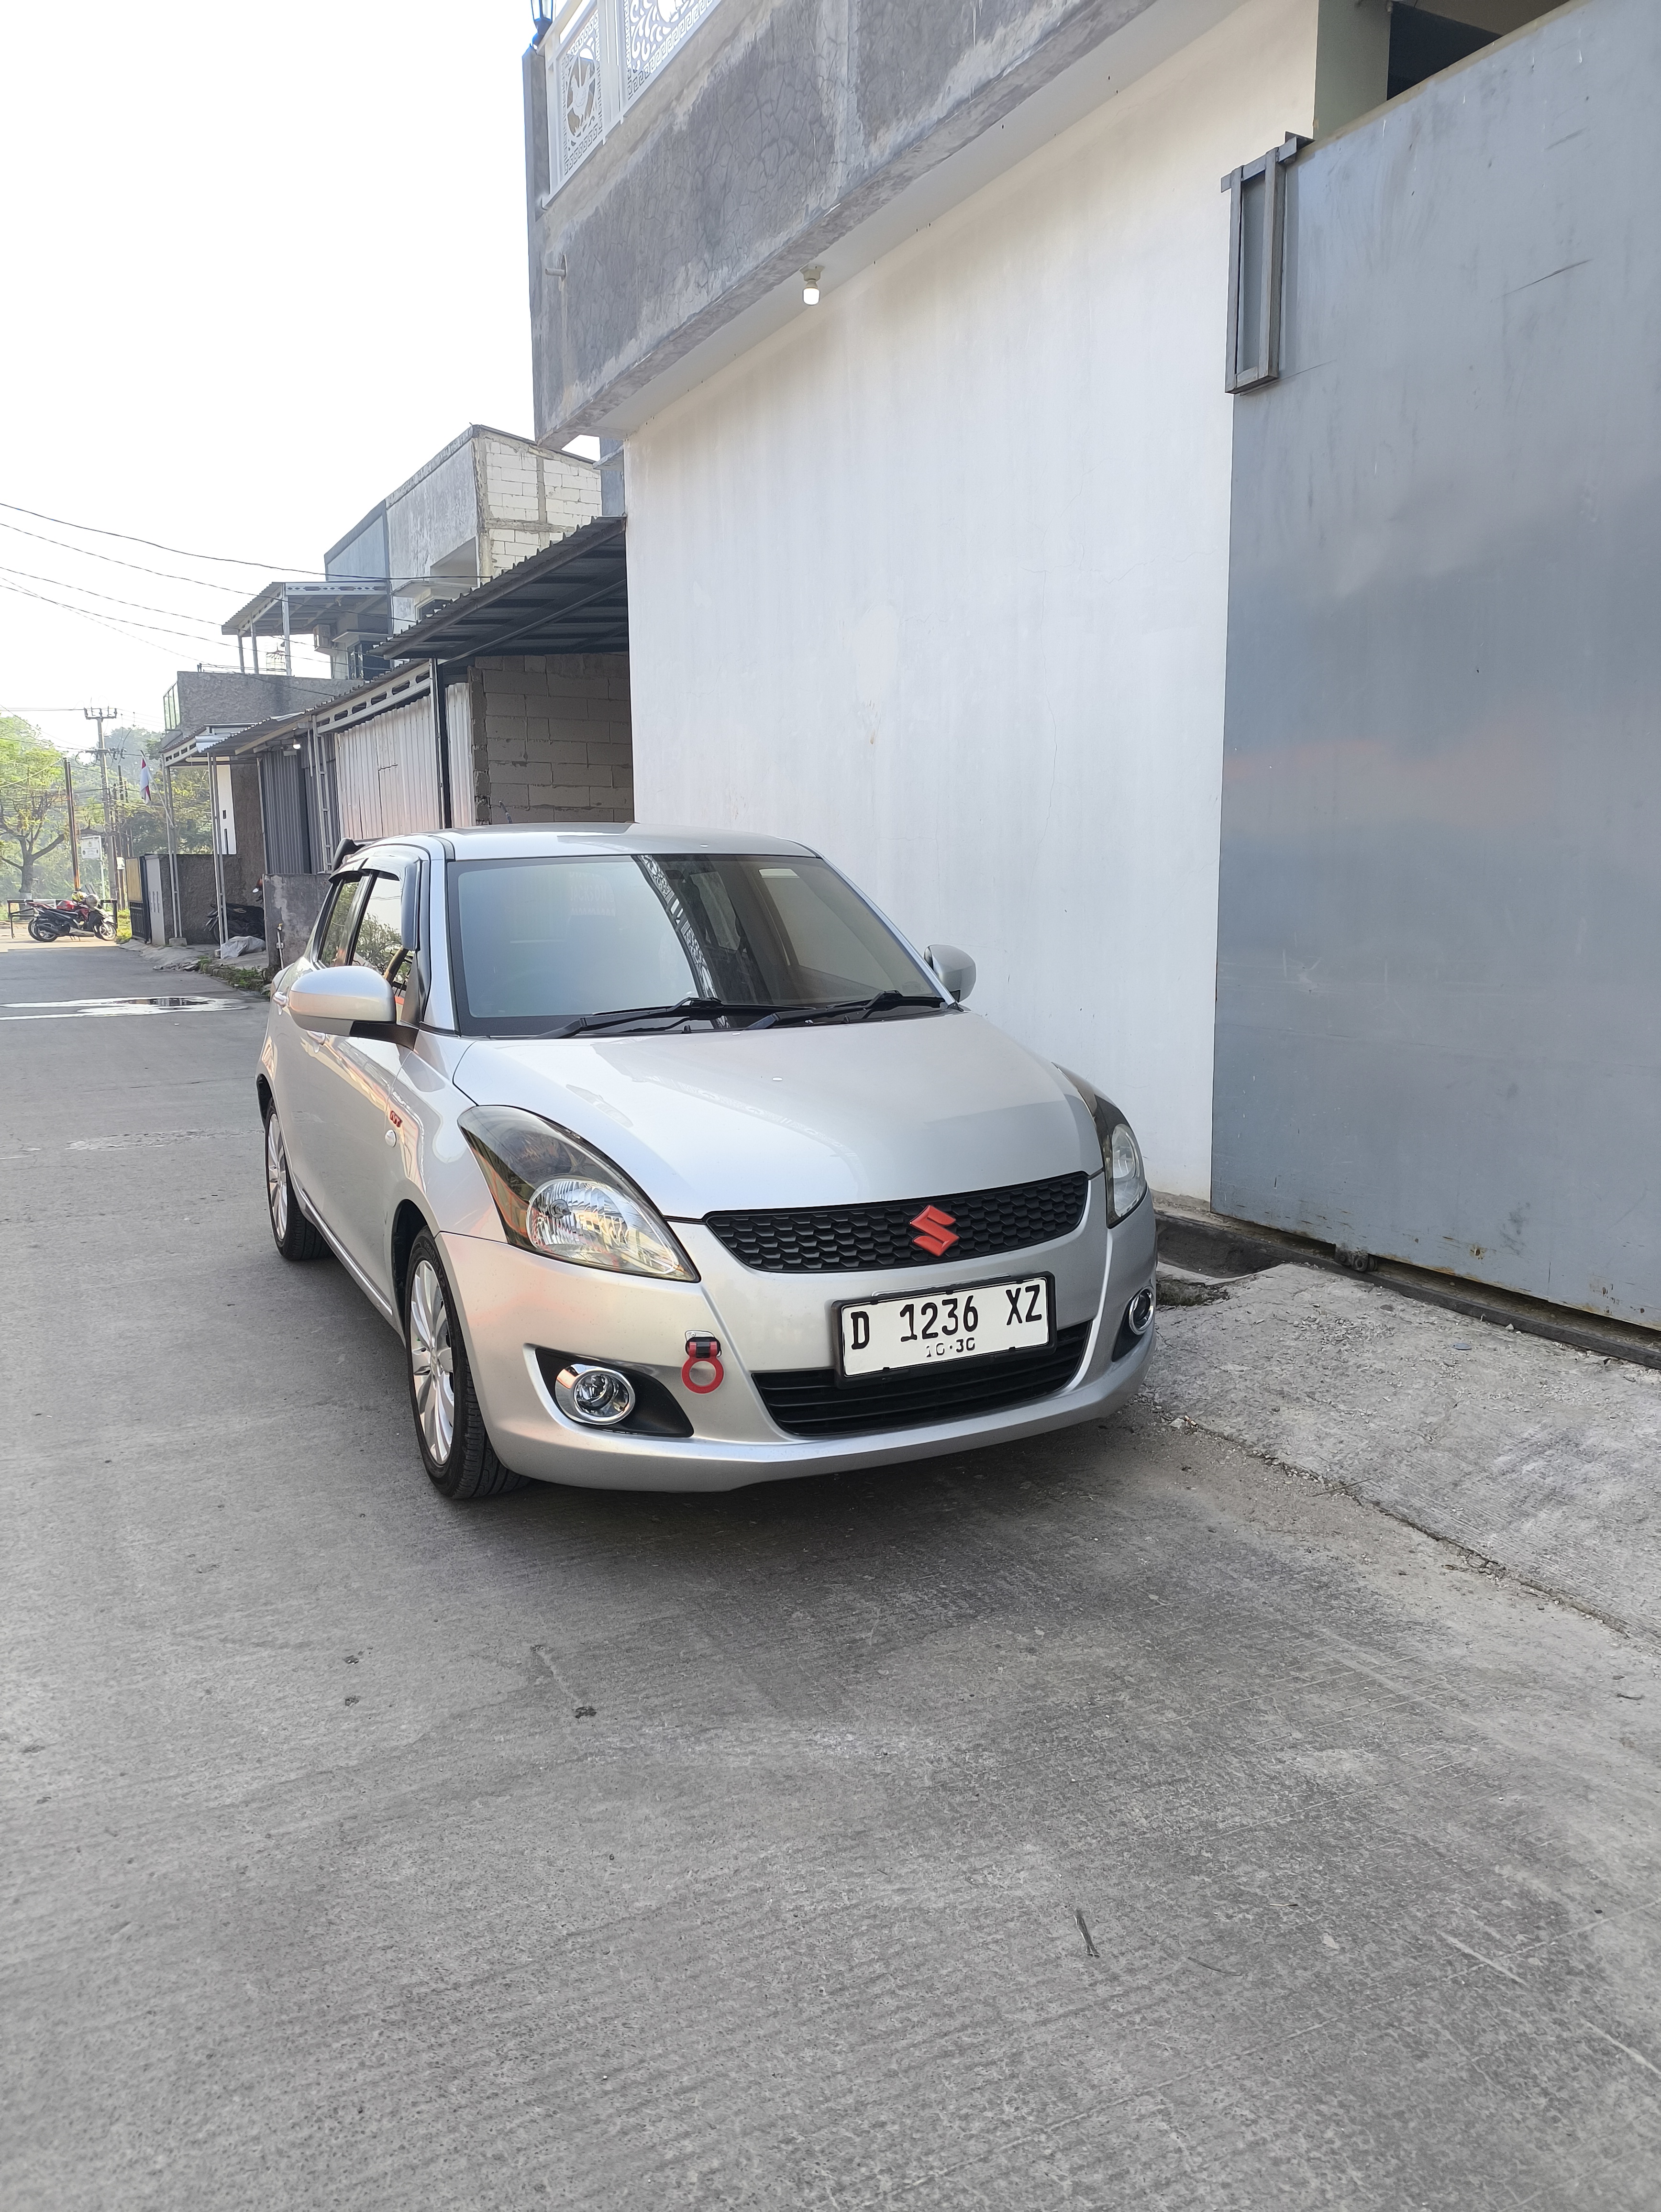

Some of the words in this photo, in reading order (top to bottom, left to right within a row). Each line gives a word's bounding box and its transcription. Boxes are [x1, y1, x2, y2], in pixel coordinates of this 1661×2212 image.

[850, 1311, 870, 1349] D
[899, 1295, 978, 1342] 1236
[1005, 1284, 1042, 1325] XZ
